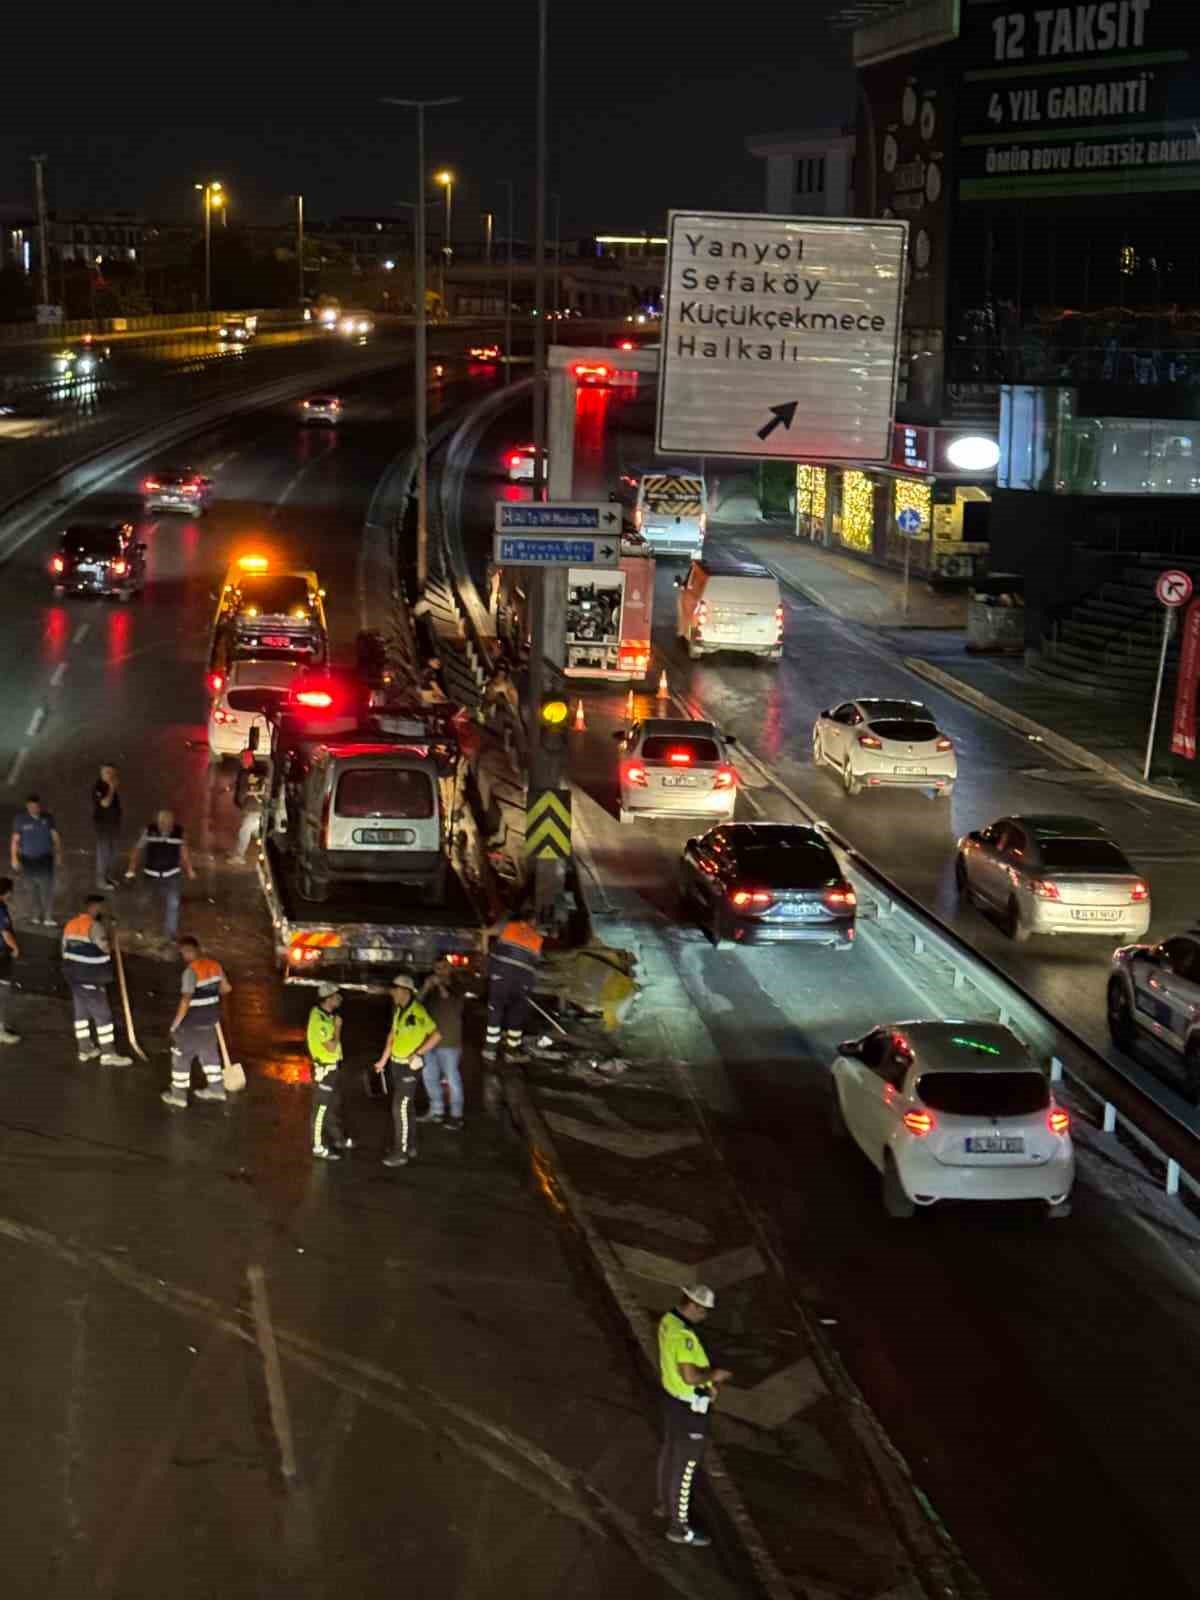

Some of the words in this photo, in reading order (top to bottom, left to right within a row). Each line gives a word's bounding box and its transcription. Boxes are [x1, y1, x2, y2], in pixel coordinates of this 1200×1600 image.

[992, 12, 1025, 61] 12
[986, 92, 1004, 124] 4
[1008, 89, 1042, 121] YIL
[685, 233, 804, 264] Yanyol
[682, 268, 820, 300] Sefaköy
[680, 301, 886, 332] Küçükçekmece
[677, 335, 798, 362] Halkalı
